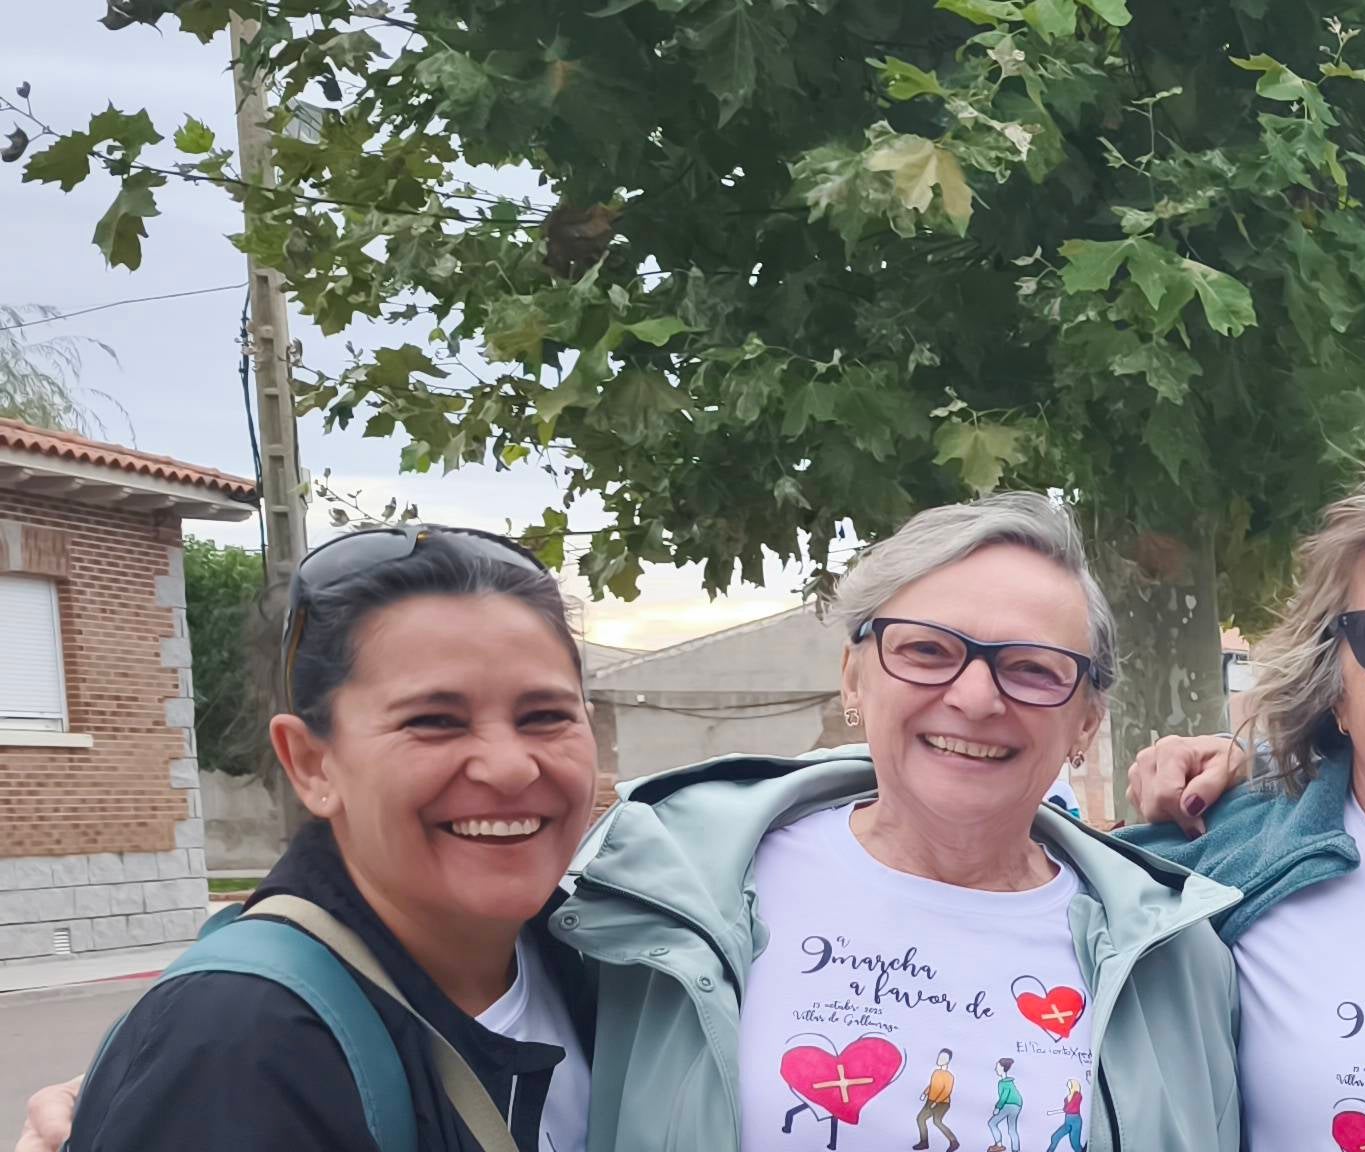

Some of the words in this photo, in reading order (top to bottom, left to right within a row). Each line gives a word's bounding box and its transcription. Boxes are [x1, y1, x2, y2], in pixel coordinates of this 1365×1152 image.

[831, 946, 938, 980] marcha
[849, 980, 866, 996] a
[874, 971, 958, 1013] favor
[966, 990, 995, 1019] de
